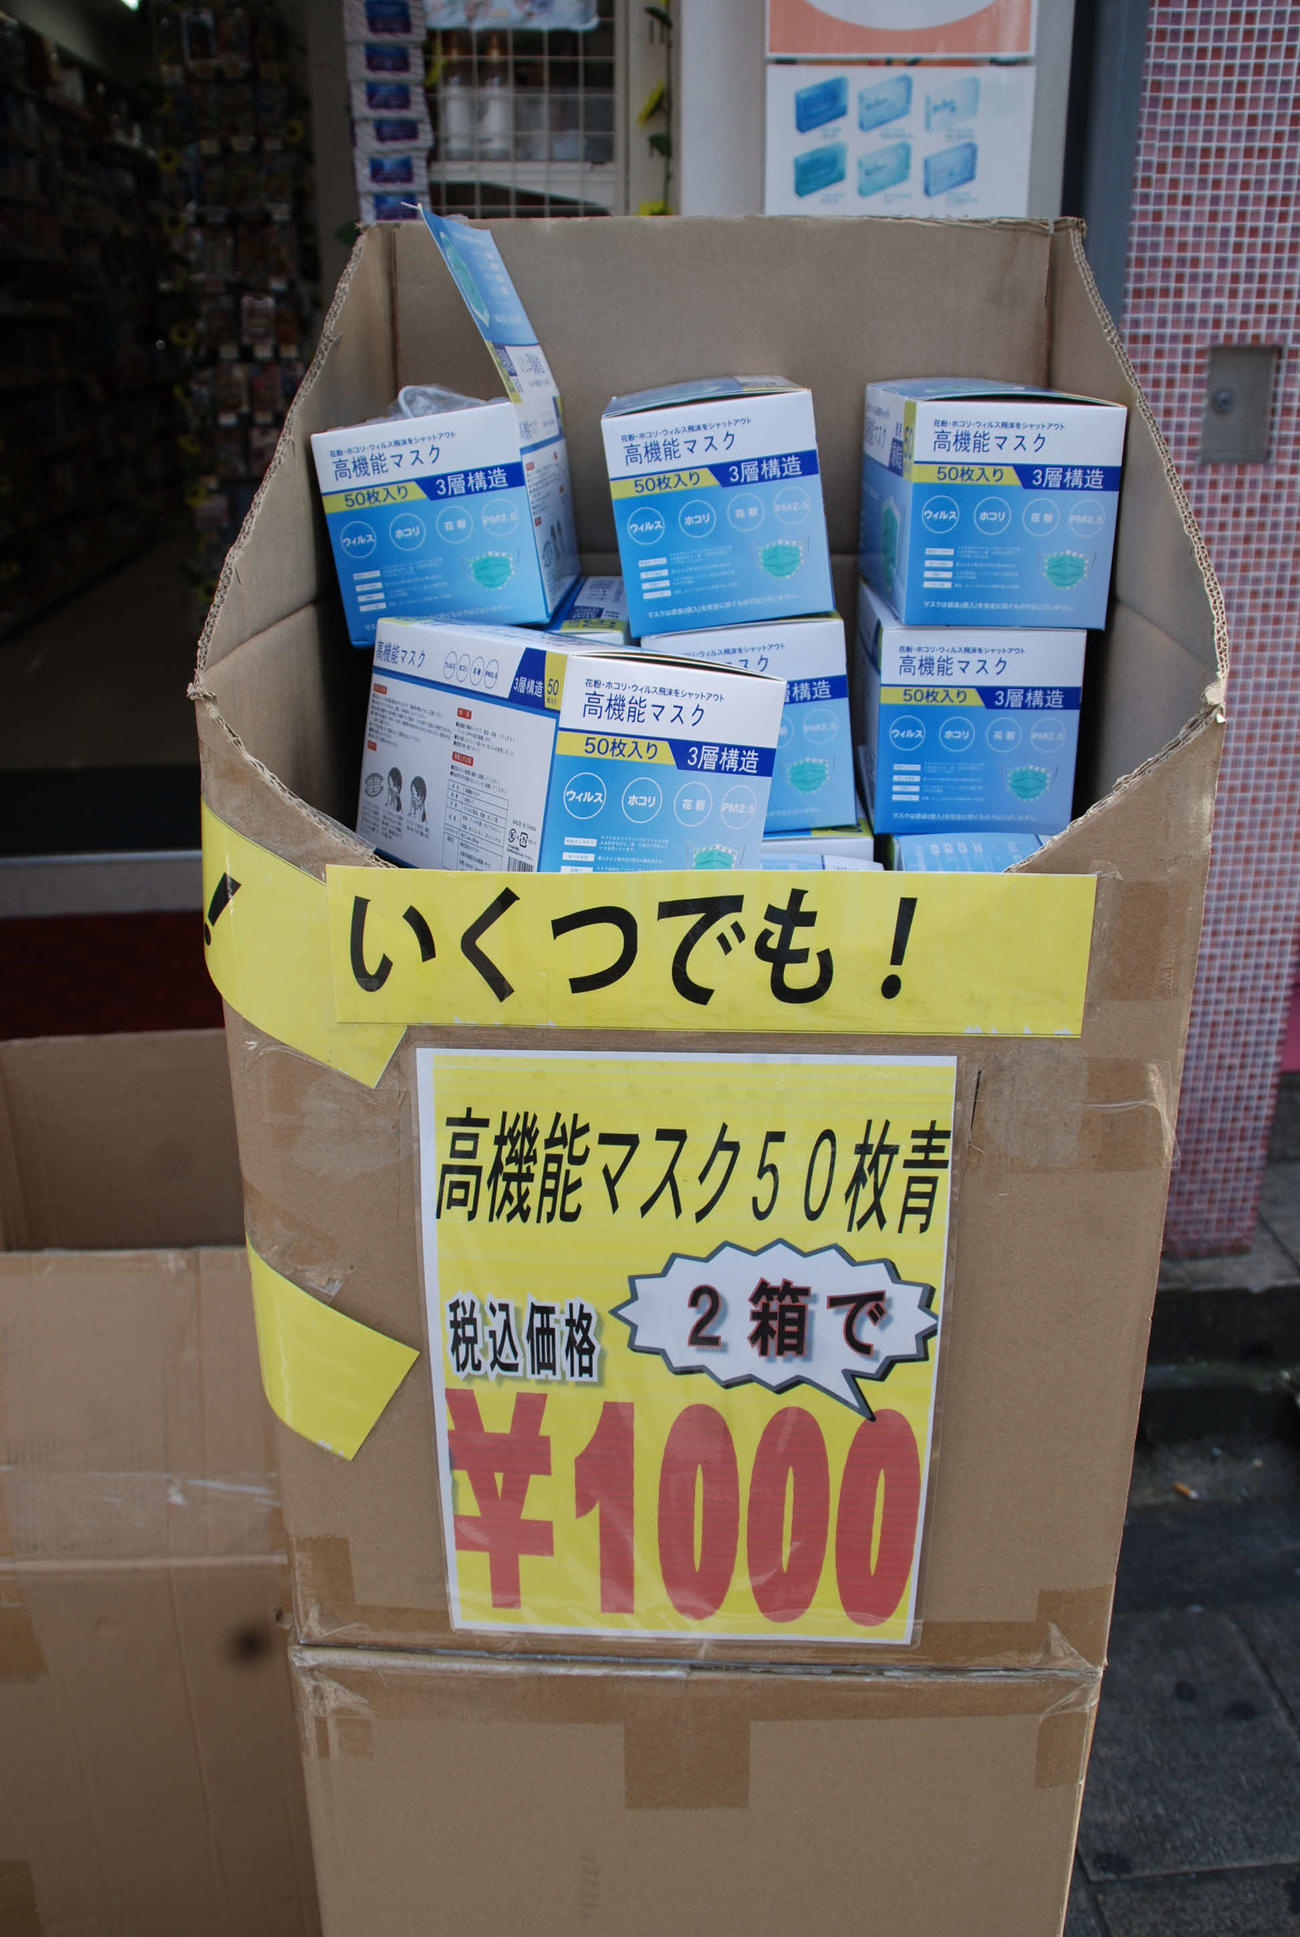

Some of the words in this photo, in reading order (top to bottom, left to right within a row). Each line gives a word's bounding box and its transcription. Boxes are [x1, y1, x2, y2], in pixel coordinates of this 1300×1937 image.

[624, 430, 736, 466] 高機能マスク
[933, 429, 1046, 453] 高機能マスク
[332, 444, 441, 482] 高機能マスク
[728, 456, 802, 484] 3層構造
[937, 466, 1004, 482] 50枚入り
[436, 468, 508, 497] 3層構造
[634, 471, 701, 494] 50枚入り
[1032, 467, 1104, 489] 3層構造
[344, 487, 408, 508] 50枚入り
[628, 520, 664, 534] ウィルス
[684, 514, 710, 526] ホコリ
[924, 510, 958, 520] ウィルス
[979, 511, 1006, 522] ホコリ
[342, 534, 376, 547] ウィルス
[394, 526, 421, 539] ホコリ
[899, 655, 1007, 677] 高機能マスク
[513, 676, 544, 698] 3層構造
[546, 679, 560, 696] 50
[902, 688, 968, 704] 50枚入り
[994, 688, 1064, 709] 3層構造
[583, 690, 706, 728] 高機能マスク
[890, 728, 924, 739] ウィルス
[944, 729, 970, 740] ホコリ
[584, 737, 658, 760] 50枚入り
[687, 746, 760, 774] 3層構造
[566, 790, 604, 804] ウィルス
[628, 794, 656, 807] ホコリ
[350, 886, 917, 1004] いくつでも!
[435, 1106, 953, 1234] 高機能マスク50枚青
[686, 1278, 887, 1357] 2箱で
[447, 1297, 597, 1378] 税込価格
[444, 1388, 921, 1628] ¥1000
